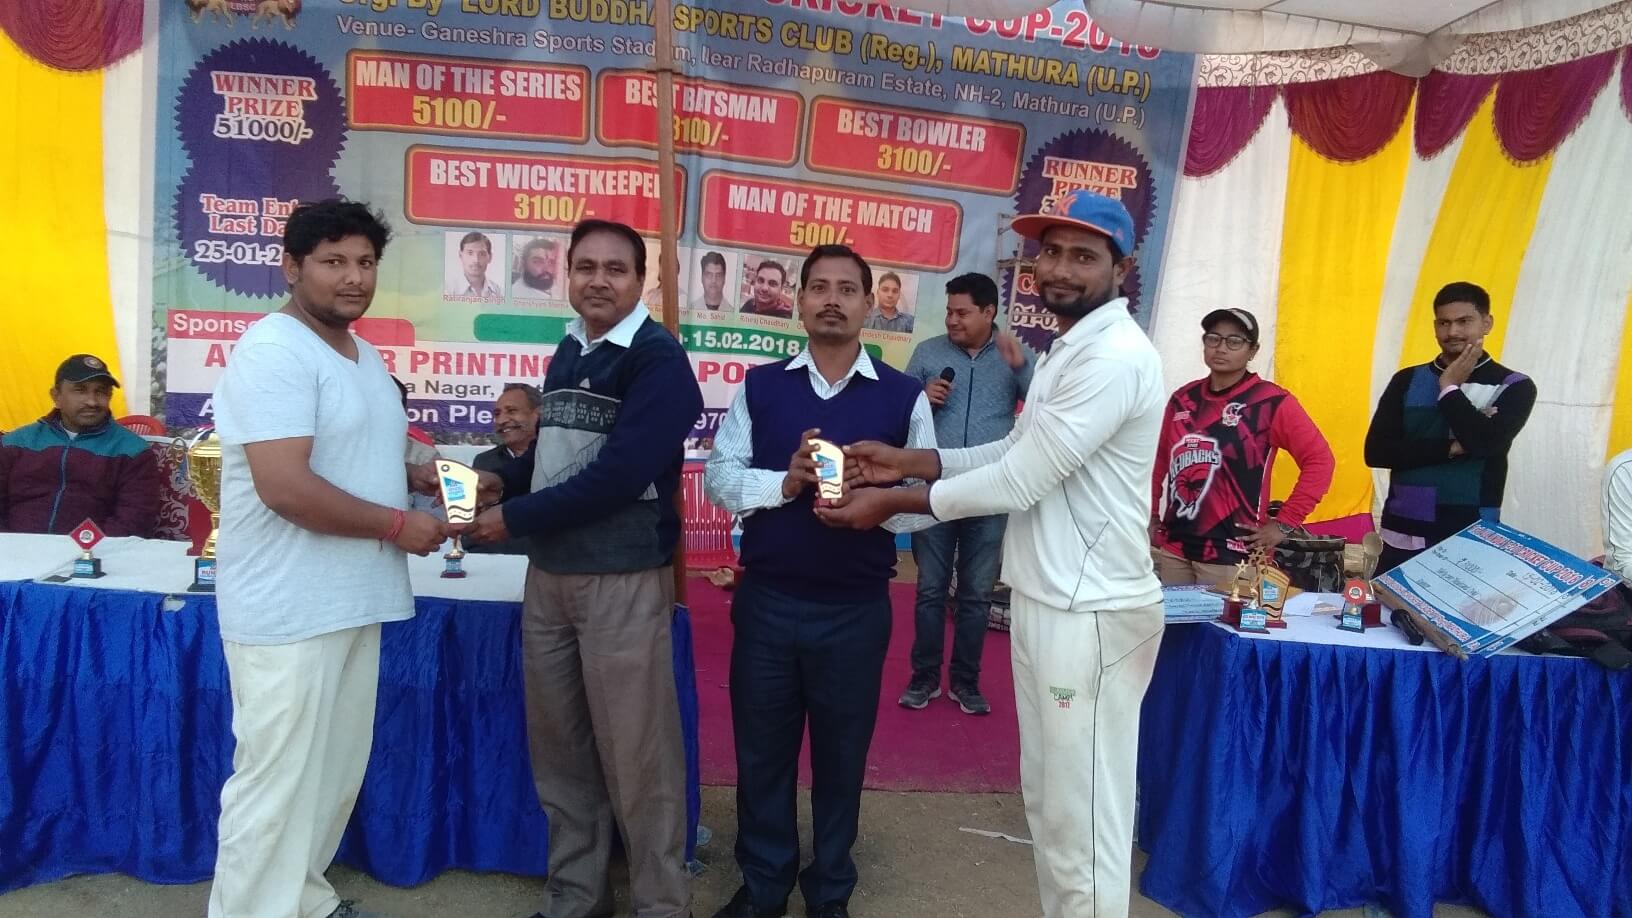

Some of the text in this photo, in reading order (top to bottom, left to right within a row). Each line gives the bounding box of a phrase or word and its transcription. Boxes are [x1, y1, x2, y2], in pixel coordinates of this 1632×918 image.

[964, 8, 1161, 60] CUP-20
[673, 4, 773, 43] SPORTS
[780, 21, 853, 55] CLUB
[860, 32, 943, 73] (Reg.),
[951, 45, 1079, 88] MATHURA
[1088, 64, 1151, 102] (U.P.)
[214, 73, 314, 98] WINNER
[336, 14, 415, 37] Venue-
[421, 21, 527, 48] Ganeshra
[533, 29, 605, 52] Sports
[747, 53, 874, 88] Radhapuram
[881, 73, 947, 100] Estate,
[954, 82, 1005, 109] NH-2,
[1013, 90, 1089, 118] Mathura
[1095, 103, 1145, 129] (U.P.)
[356, 60, 581, 101] MAN OF THE SERIES
[227, 96, 300, 117] PRIZE
[412, 95, 507, 129] 5100/-
[683, 86, 777, 123] BATSMAN
[217, 118, 310, 141] 51000/-
[837, 108, 986, 152] BEST BOWLER
[430, 158, 491, 187] BEST
[878, 144, 952, 176] 3100/-
[1045, 159, 1134, 186] RUNNER
[202, 195, 257, 214] Team
[514, 193, 595, 222] 3100/-
[728, 184, 933, 233] MAN OF THE MATCH
[210, 215, 255, 234] Last
[789, 220, 854, 247] 500/-
[693, 330, 800, 356] 15.02.2018
[425, 380, 494, 398] Nagar,
[450, 404, 495, 424] Ple
